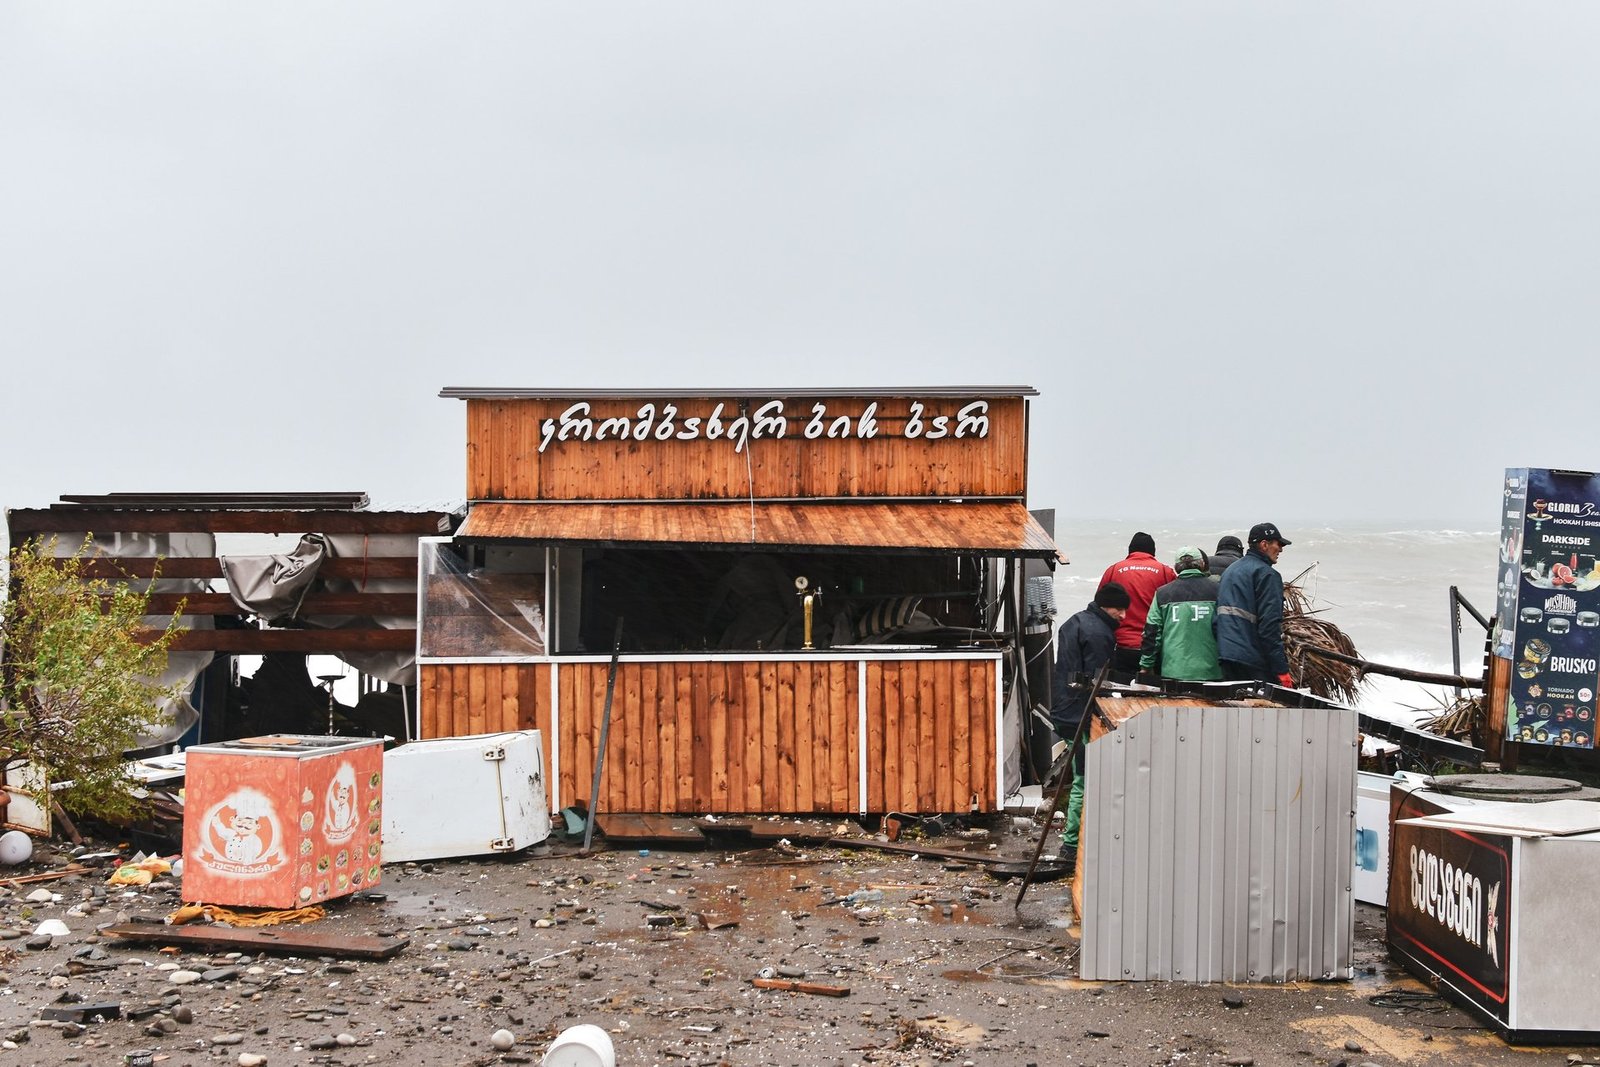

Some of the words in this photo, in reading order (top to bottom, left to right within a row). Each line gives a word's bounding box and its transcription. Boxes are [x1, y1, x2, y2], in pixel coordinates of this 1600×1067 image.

[904, 401, 990, 439] ბარ
[1547, 502, 1580, 514] GLORIA
[1553, 518, 1581, 526] HOOKAH
[1541, 534, 1591, 546] DARKSIDE
[1550, 656, 1596, 674] BRUSKO
